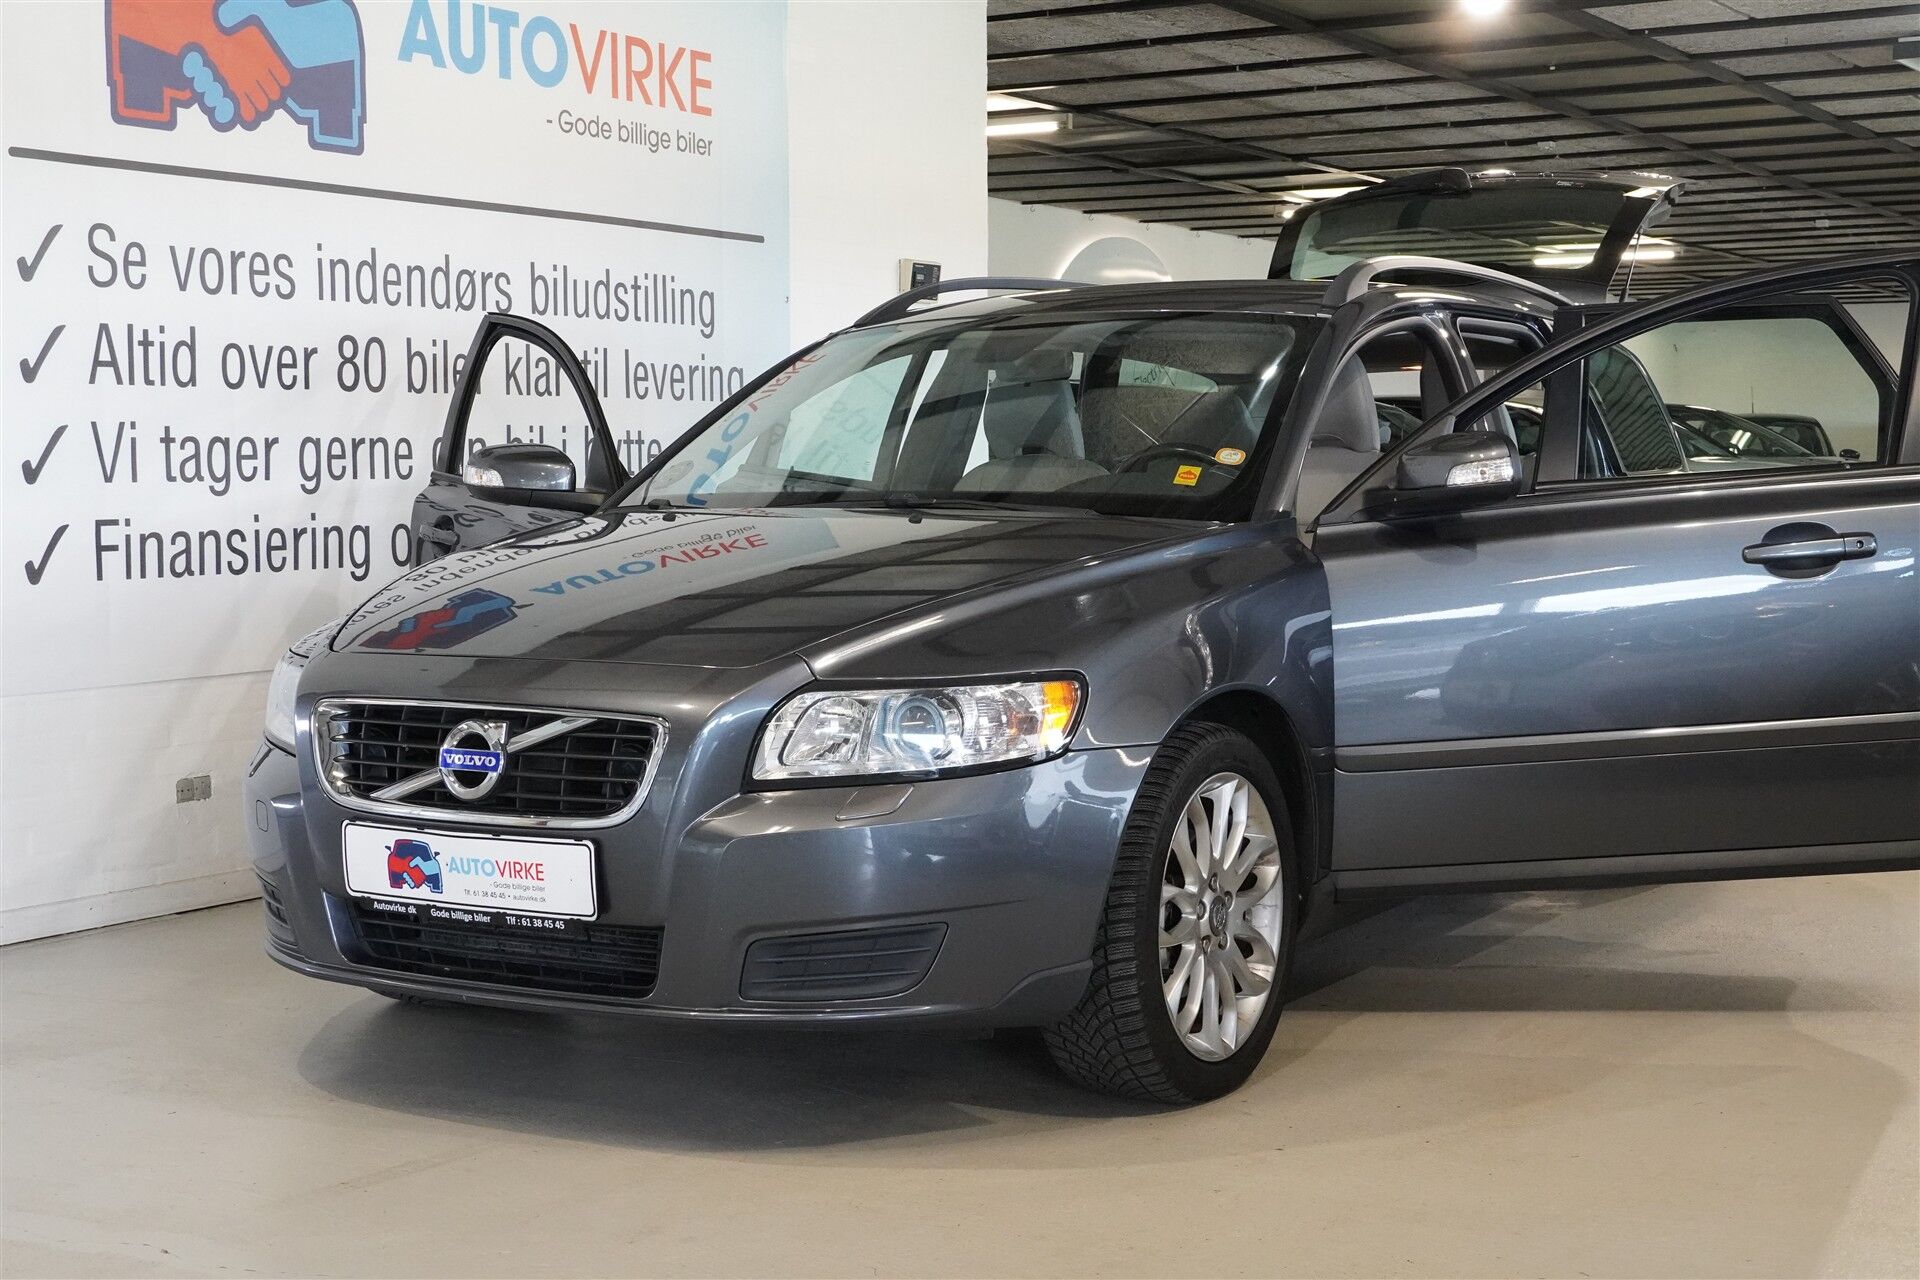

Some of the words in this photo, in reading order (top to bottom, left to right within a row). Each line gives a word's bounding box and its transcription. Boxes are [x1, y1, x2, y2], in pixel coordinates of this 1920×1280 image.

[397, 0, 713, 117] AUTOVIRKE
[558, 109, 612, 140] Gode
[618, 119, 671, 153] billige
[676, 129, 713, 157] biler
[87, 222, 147, 290] Se
[169, 245, 296, 300] vores
[317, 244, 513, 313] indendørs
[529, 262, 715, 339] biludstilling
[88, 322, 197, 388] Altid
[221, 342, 319, 393] over
[336, 335, 387, 393] 80
[406, 337, 481, 395] bile
[90, 421, 138, 484] Vi
[160, 426, 280, 497] tager
[298, 436, 414, 495] gerne
[94, 512, 371, 582] Finansiering
[443, 752, 497, 767] VOLVO
[448, 856, 545, 882] AUTOVIRKE
[430, 908, 450, 918] Gode
[451, 910, 473, 922] billige
[473, 912, 491, 923] biler
[481, 890, 489, 898] 38
[490, 891, 498, 899] 45
[498, 892, 506, 900] 45
[505, 916, 516, 925] Tlf
[521, 917, 532, 927] 61
[532, 919, 543, 928] 38
[543, 920, 554, 929] 45
[554, 921, 565, 930] 45
